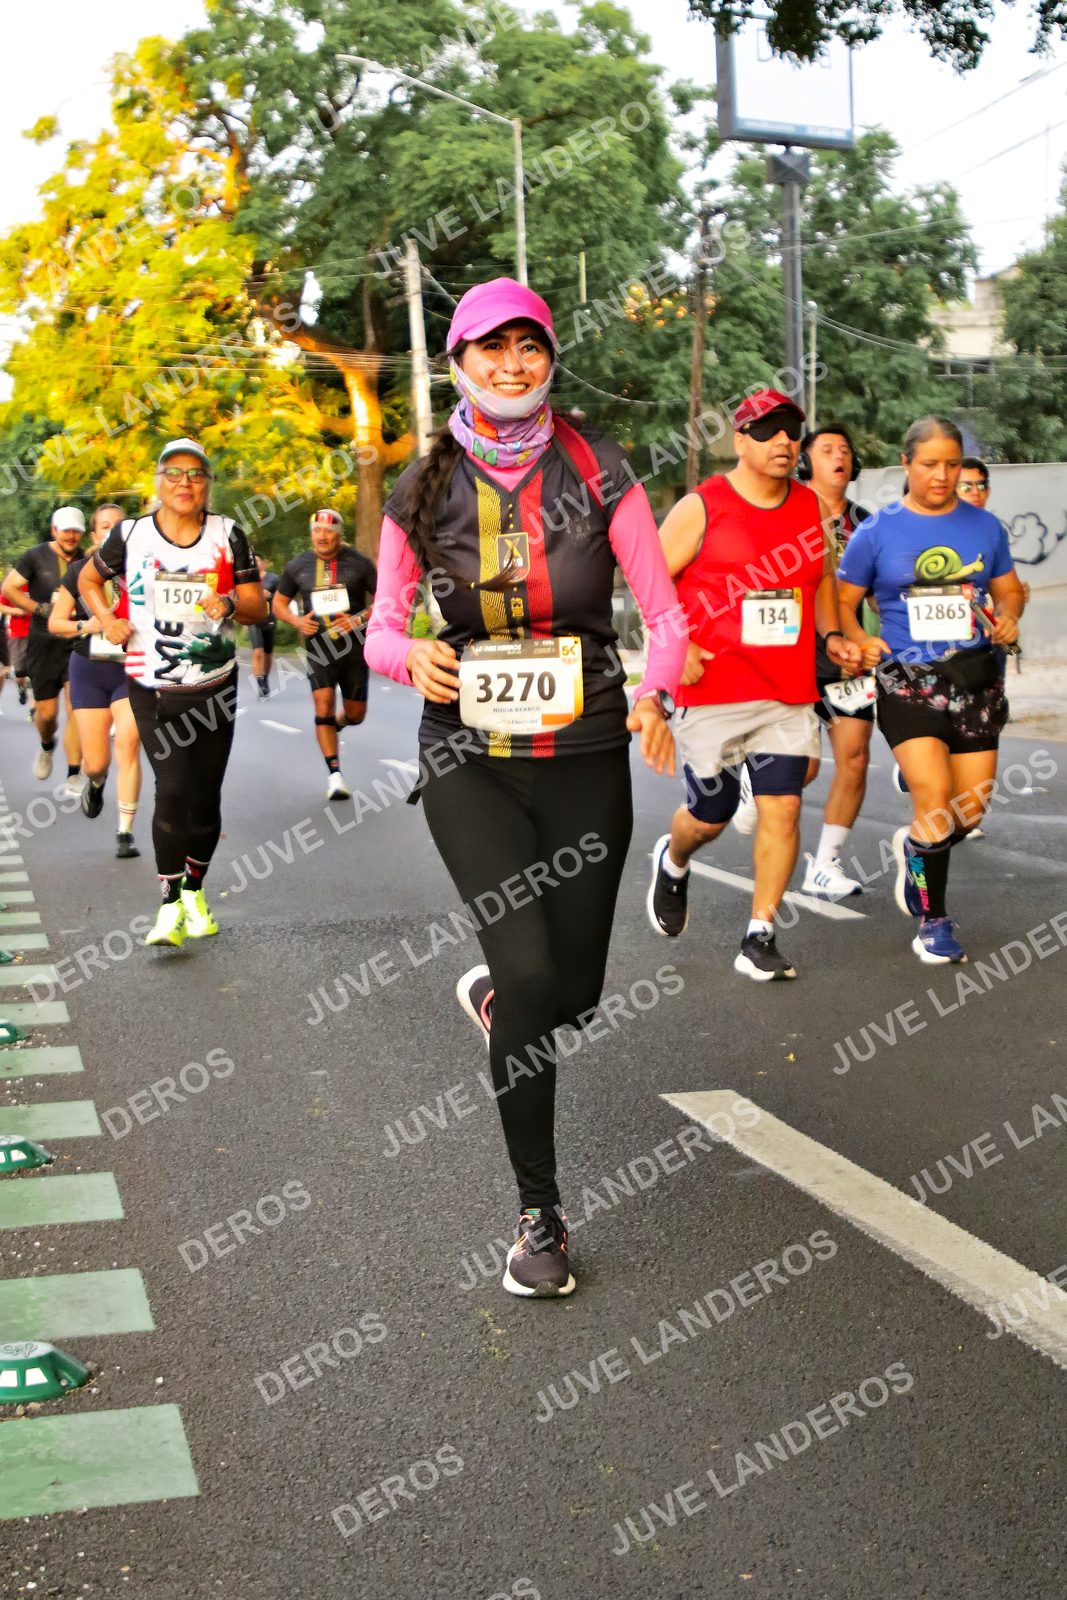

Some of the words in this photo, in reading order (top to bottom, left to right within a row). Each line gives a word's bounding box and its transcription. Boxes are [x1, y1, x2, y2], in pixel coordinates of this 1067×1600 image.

[163, 588, 203, 604] 1507
[758, 606, 788, 624] 134
[913, 603, 966, 620] 12865
[561, 645, 577, 656] 5K
[476, 671, 556, 703] 3270
